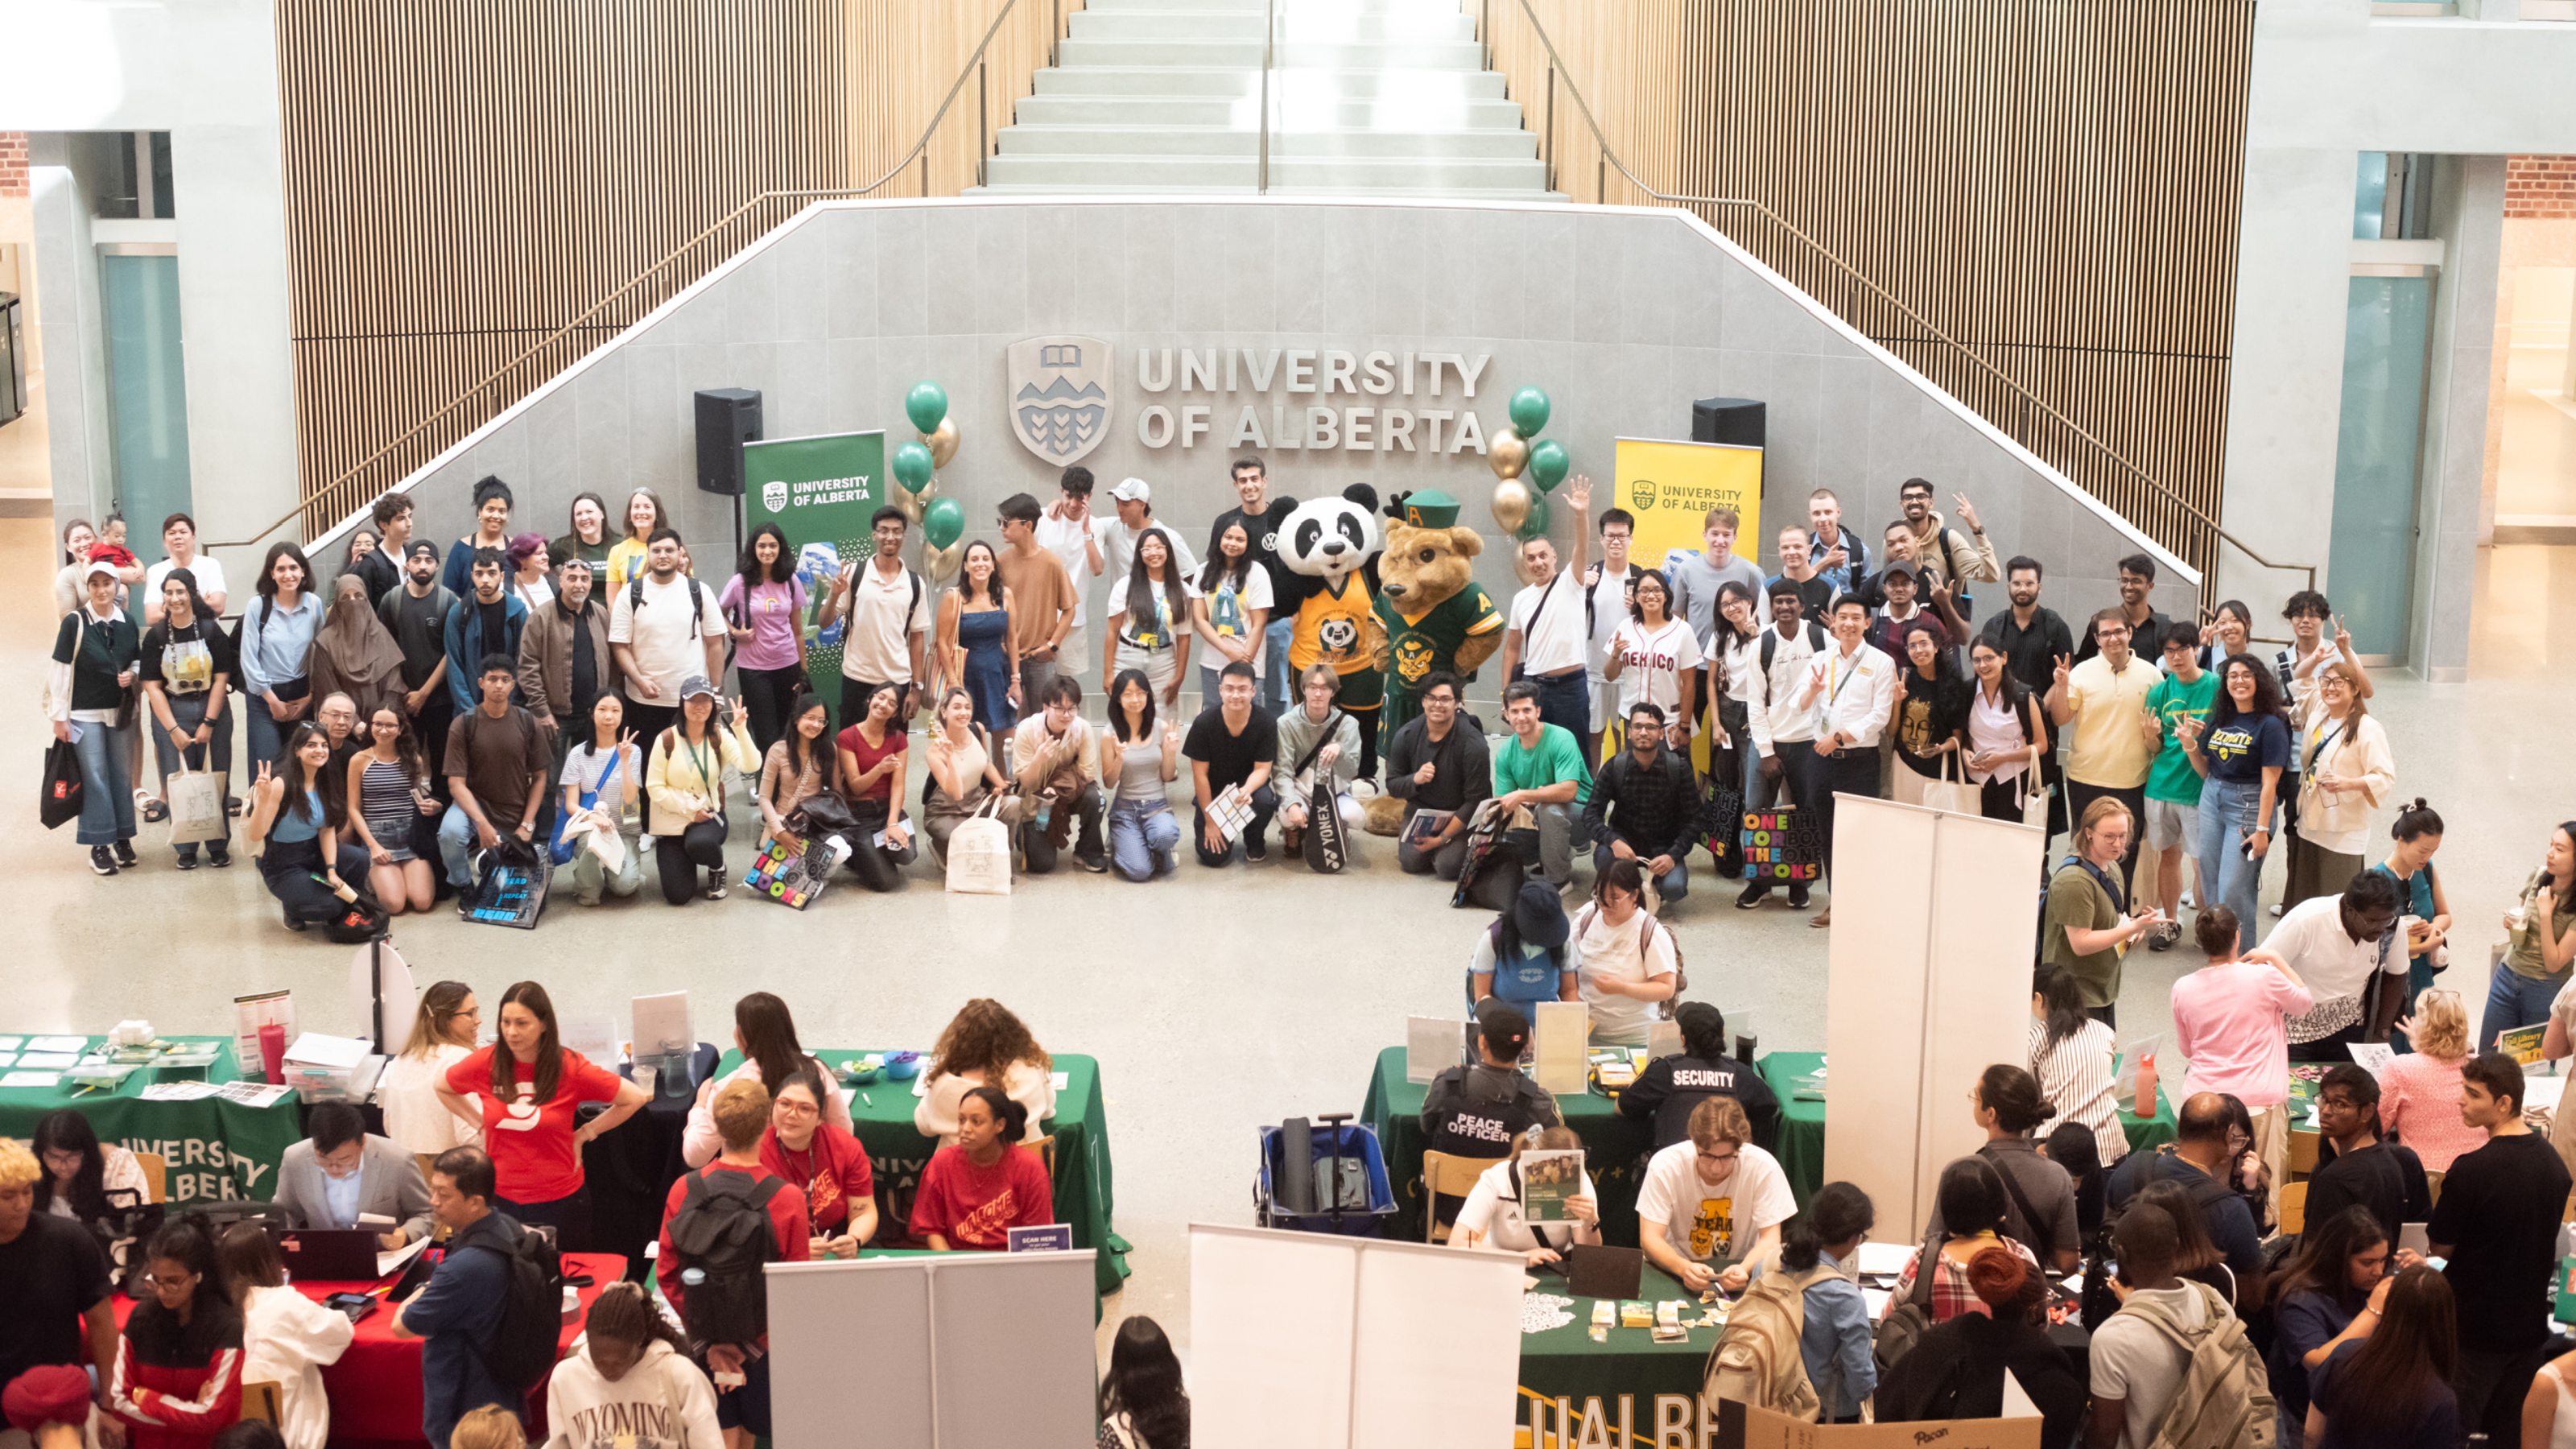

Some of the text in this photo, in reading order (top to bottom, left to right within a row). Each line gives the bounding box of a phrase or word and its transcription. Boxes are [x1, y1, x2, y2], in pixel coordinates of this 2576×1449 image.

[1137, 348, 1492, 397] UNIVERSITY
[1137, 405, 1487, 455] OF ALBERTA
[793, 475, 869, 493] UNIVERSITY
[1662, 485, 1742, 501] UNIVERSITY
[793, 489, 870, 506] OF ALBERTA
[1662, 498, 1678, 509] OF
[1408, 506, 1424, 527] A
[1478, 592, 1492, 613] A
[1316, 804, 1335, 846] YONEX
[1744, 813, 1788, 830] ONE
[1744, 830, 1785, 847] FOR
[1744, 847, 1781, 863] THE
[755, 854, 790, 881] THE
[1744, 862, 1817, 880] BOOKS
[745, 868, 807, 907] BOOKS
[1674, 1070, 1734, 1088] SECURITY
[1447, 1121, 1511, 1142] OFFICER
[1457, 1113, 1504, 1132] PEACE
[572, 1402, 671, 1443] WYOMING
[1913, 1427, 1949, 1447] Pacon
